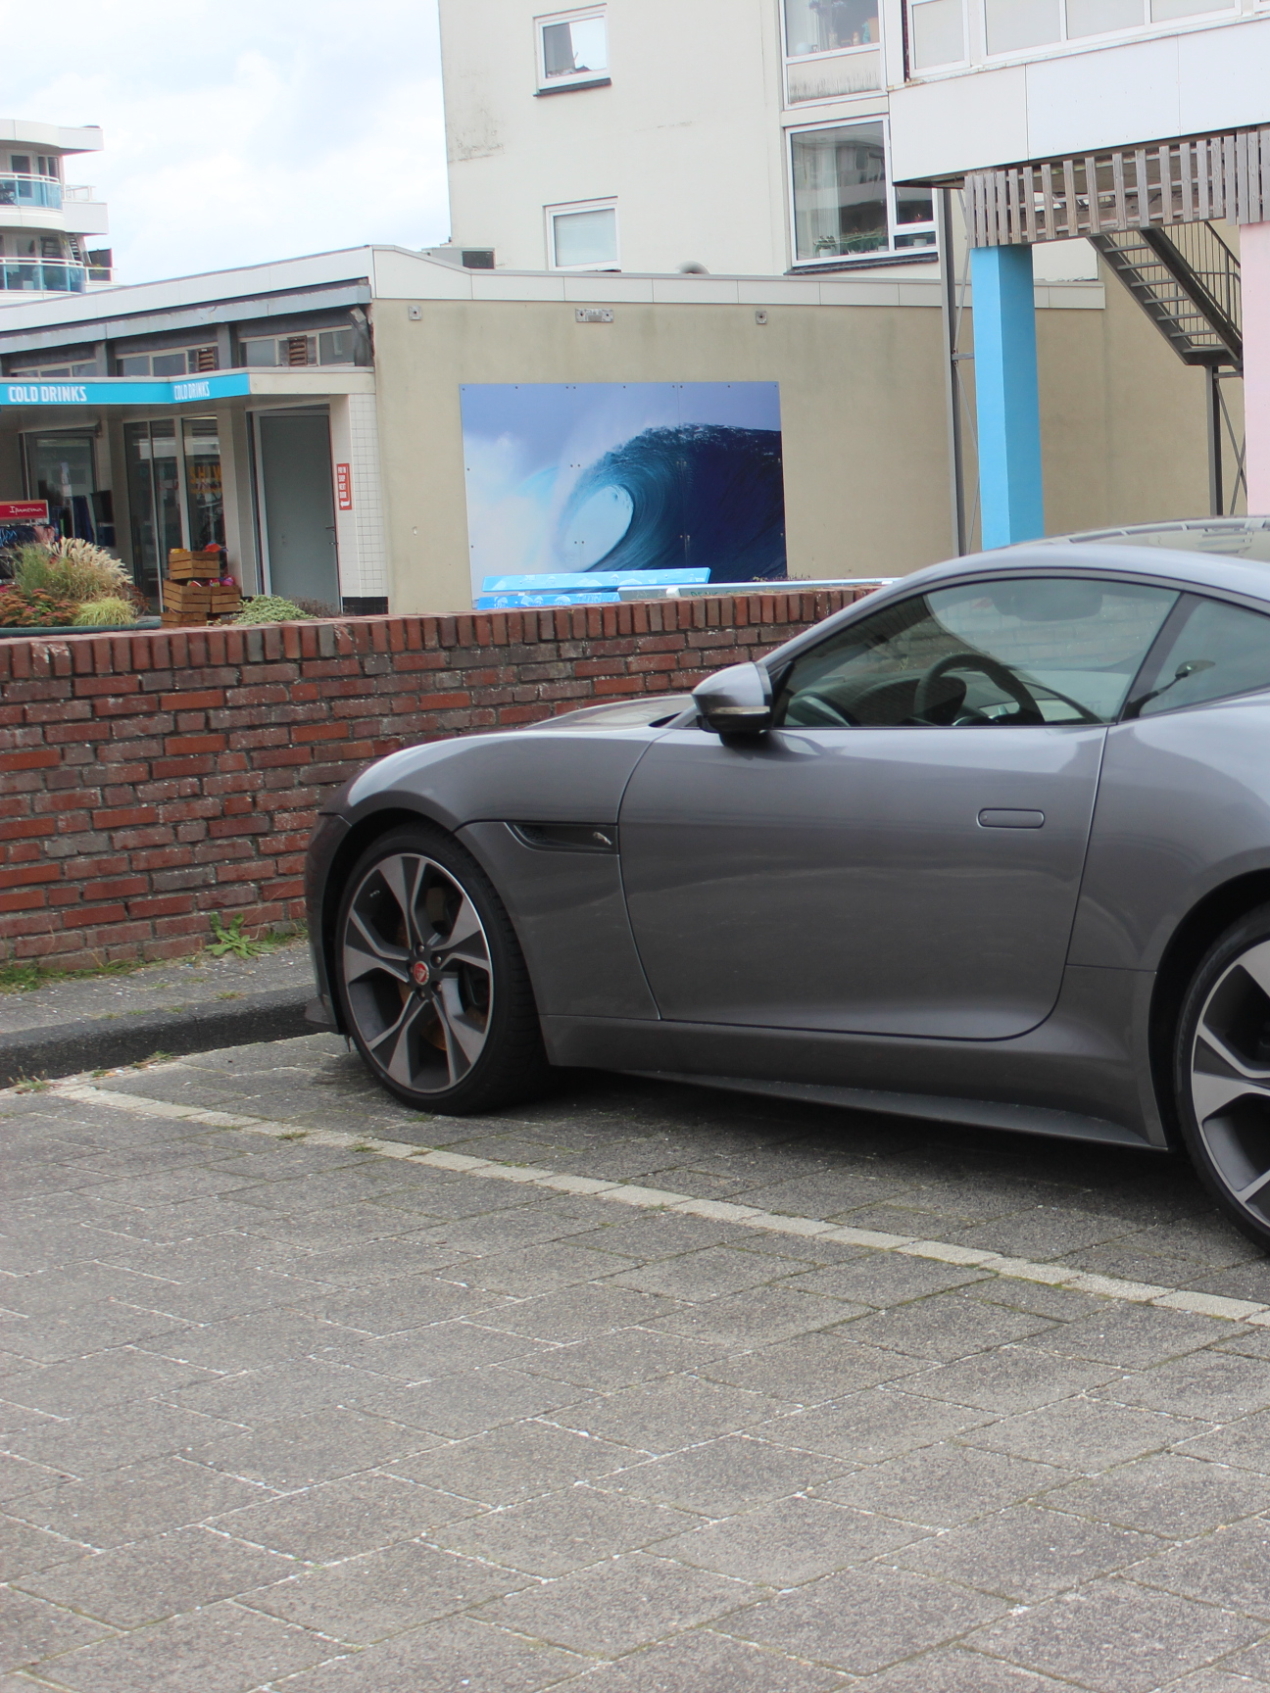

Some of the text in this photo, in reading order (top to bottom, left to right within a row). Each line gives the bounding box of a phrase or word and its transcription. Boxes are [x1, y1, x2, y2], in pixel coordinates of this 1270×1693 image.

[8, 385, 87, 402] COLD DRINKS
[174, 381, 210, 400] COLD DRINKS
